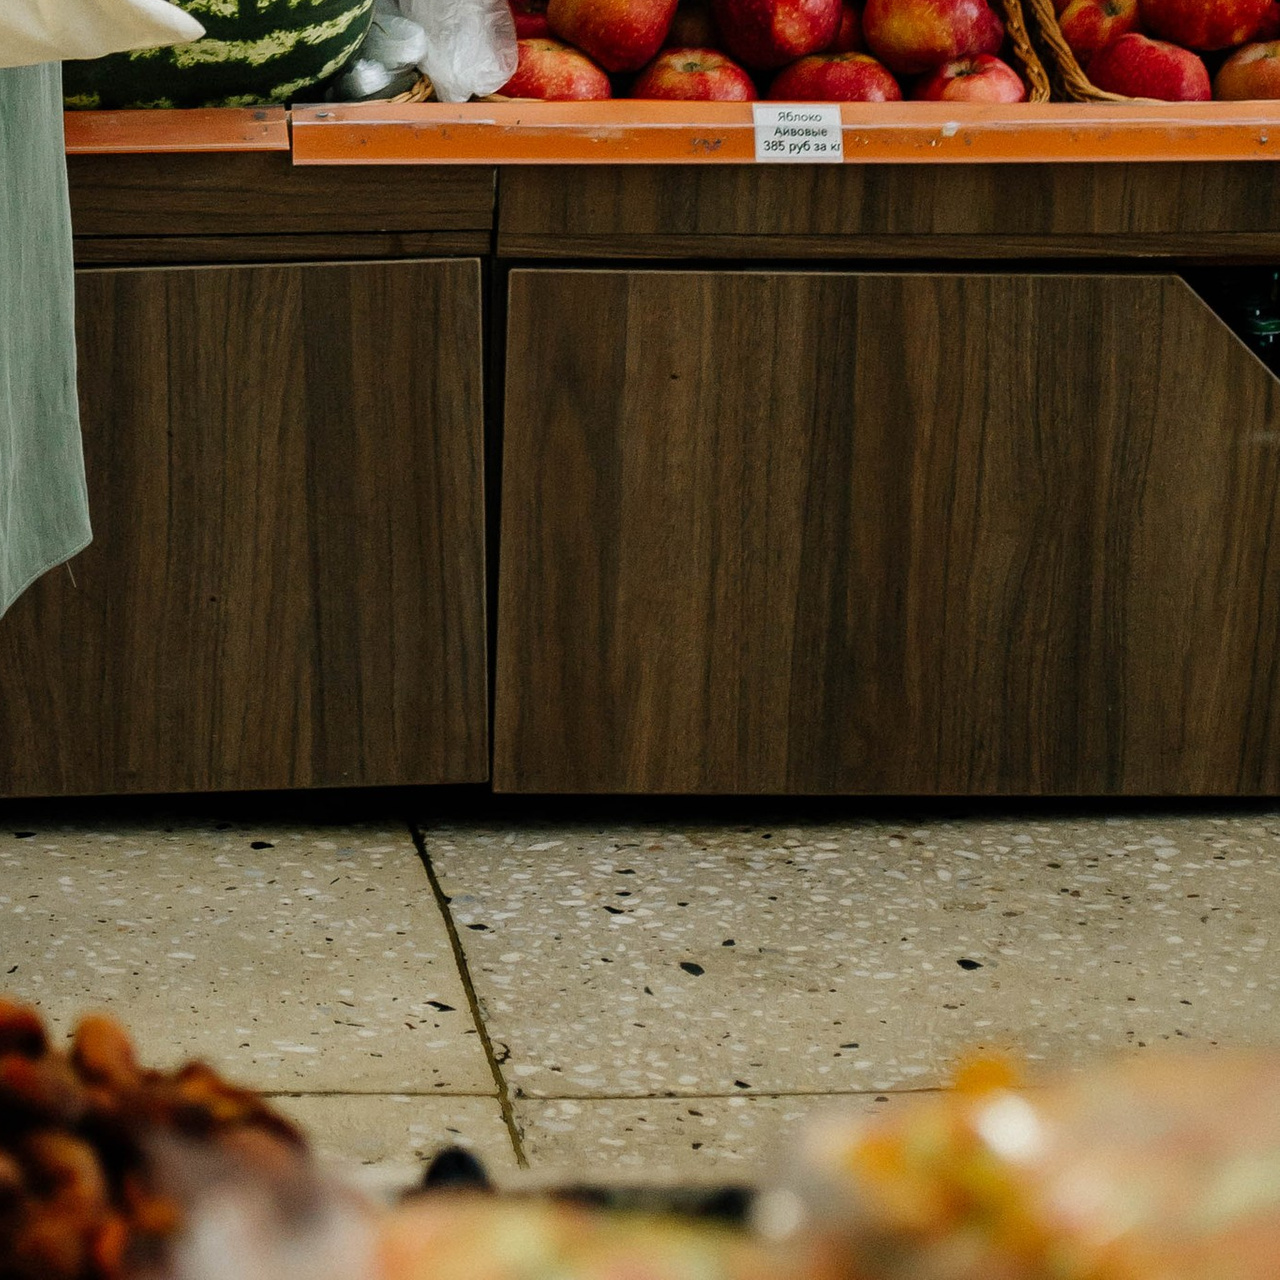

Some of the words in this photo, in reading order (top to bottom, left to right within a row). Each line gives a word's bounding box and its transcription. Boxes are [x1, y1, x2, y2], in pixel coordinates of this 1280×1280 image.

[778, 111, 822, 122] Яблоко
[763, 140, 785, 152] 385
[789, 140, 811, 154] руб
[814, 142, 827, 152] за
